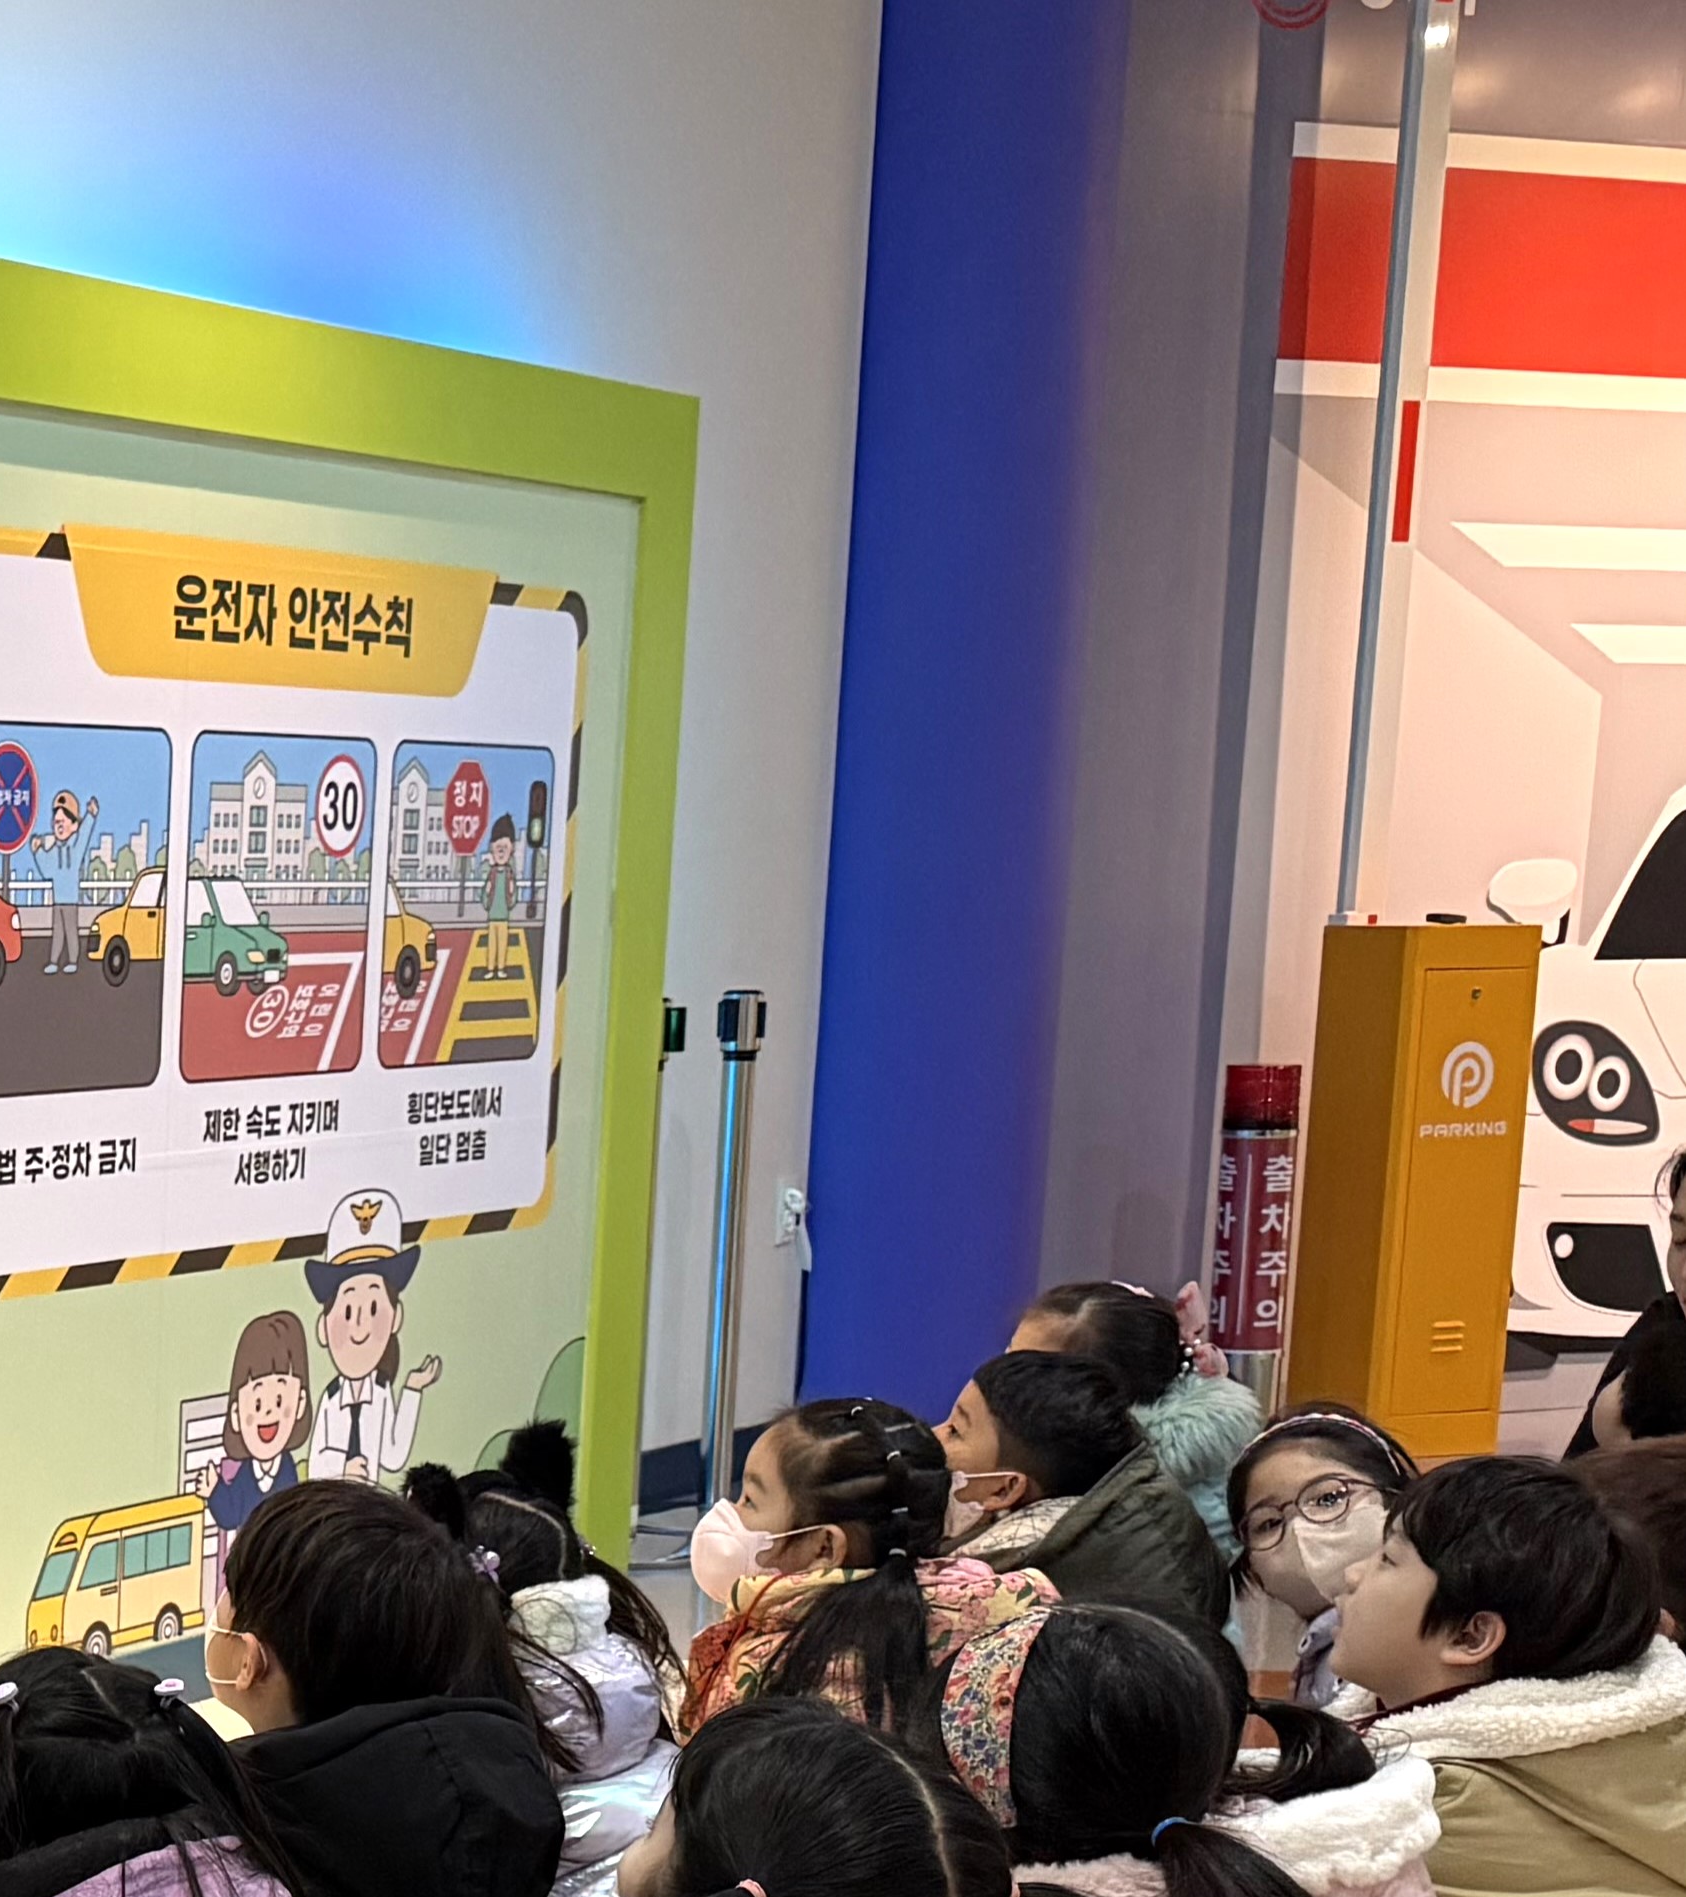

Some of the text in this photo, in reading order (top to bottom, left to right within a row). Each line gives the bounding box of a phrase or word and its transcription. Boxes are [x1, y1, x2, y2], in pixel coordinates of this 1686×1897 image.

[174, 574, 414, 658] 운전자 안전수칙
[322, 781, 358, 832] 30
[451, 815, 480, 839] STOP
[252, 992, 282, 1029] 30
[203, 1099, 340, 1143] 제한 속도 지키며
[407, 1086, 503, 1125] 횡단보도에서
[419, 1130, 487, 1166] 일단 멈춤
[1419, 1120, 1507, 1138] PARKING
[98, 1137, 137, 1175] 금지
[234, 1147, 306, 1186] 서행하기
